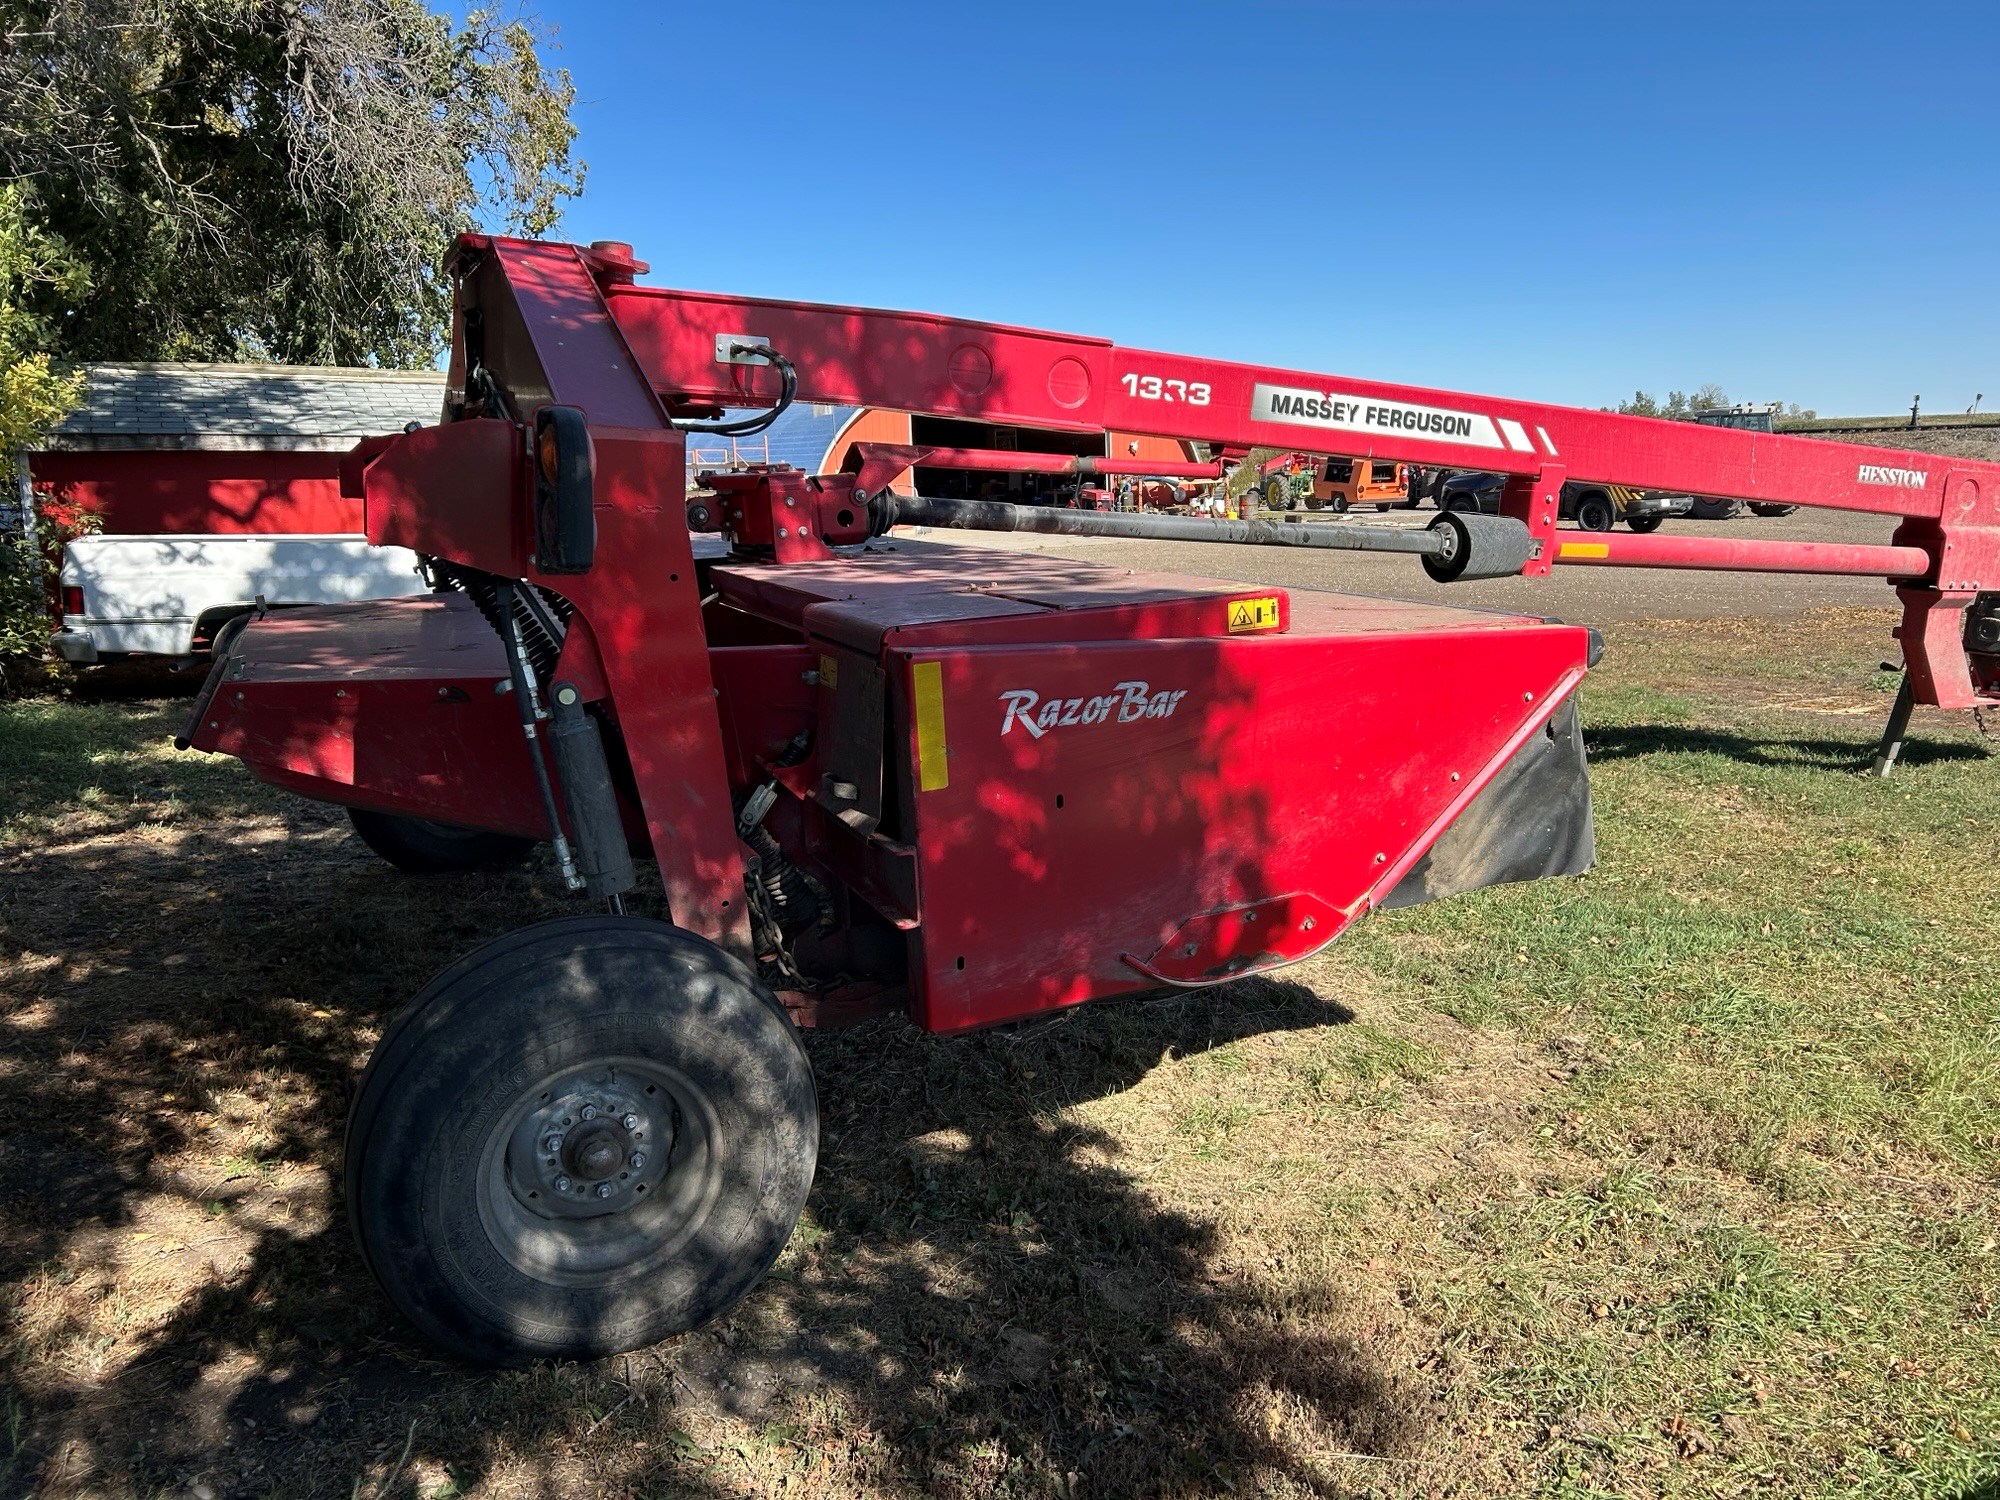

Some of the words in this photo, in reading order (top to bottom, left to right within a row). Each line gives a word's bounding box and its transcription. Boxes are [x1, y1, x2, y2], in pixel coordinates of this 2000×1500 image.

[1121, 374, 1212, 406] 1333
[1270, 394, 1359, 425] MASSEY
[1365, 407, 1472, 437] FERGUSON
[1858, 465, 1928, 489] HESSTON
[998, 680, 1189, 739] RazorBar
